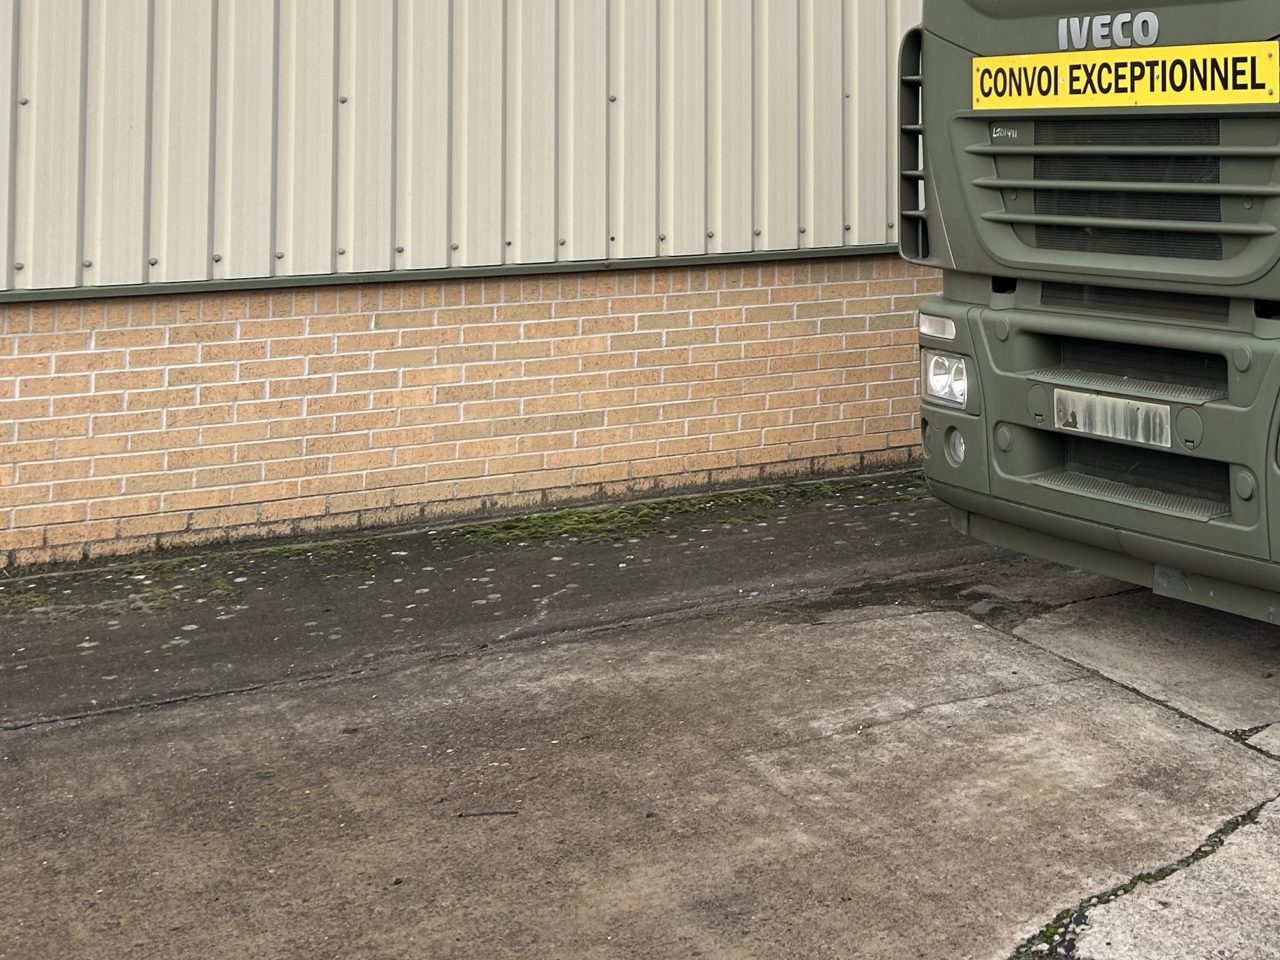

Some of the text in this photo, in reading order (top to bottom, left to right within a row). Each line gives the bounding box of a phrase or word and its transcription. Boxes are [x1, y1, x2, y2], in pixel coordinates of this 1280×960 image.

[1057, 11, 1160, 50] IVECO
[978, 55, 1267, 98] CONVOI EXCEPTIONNEL
